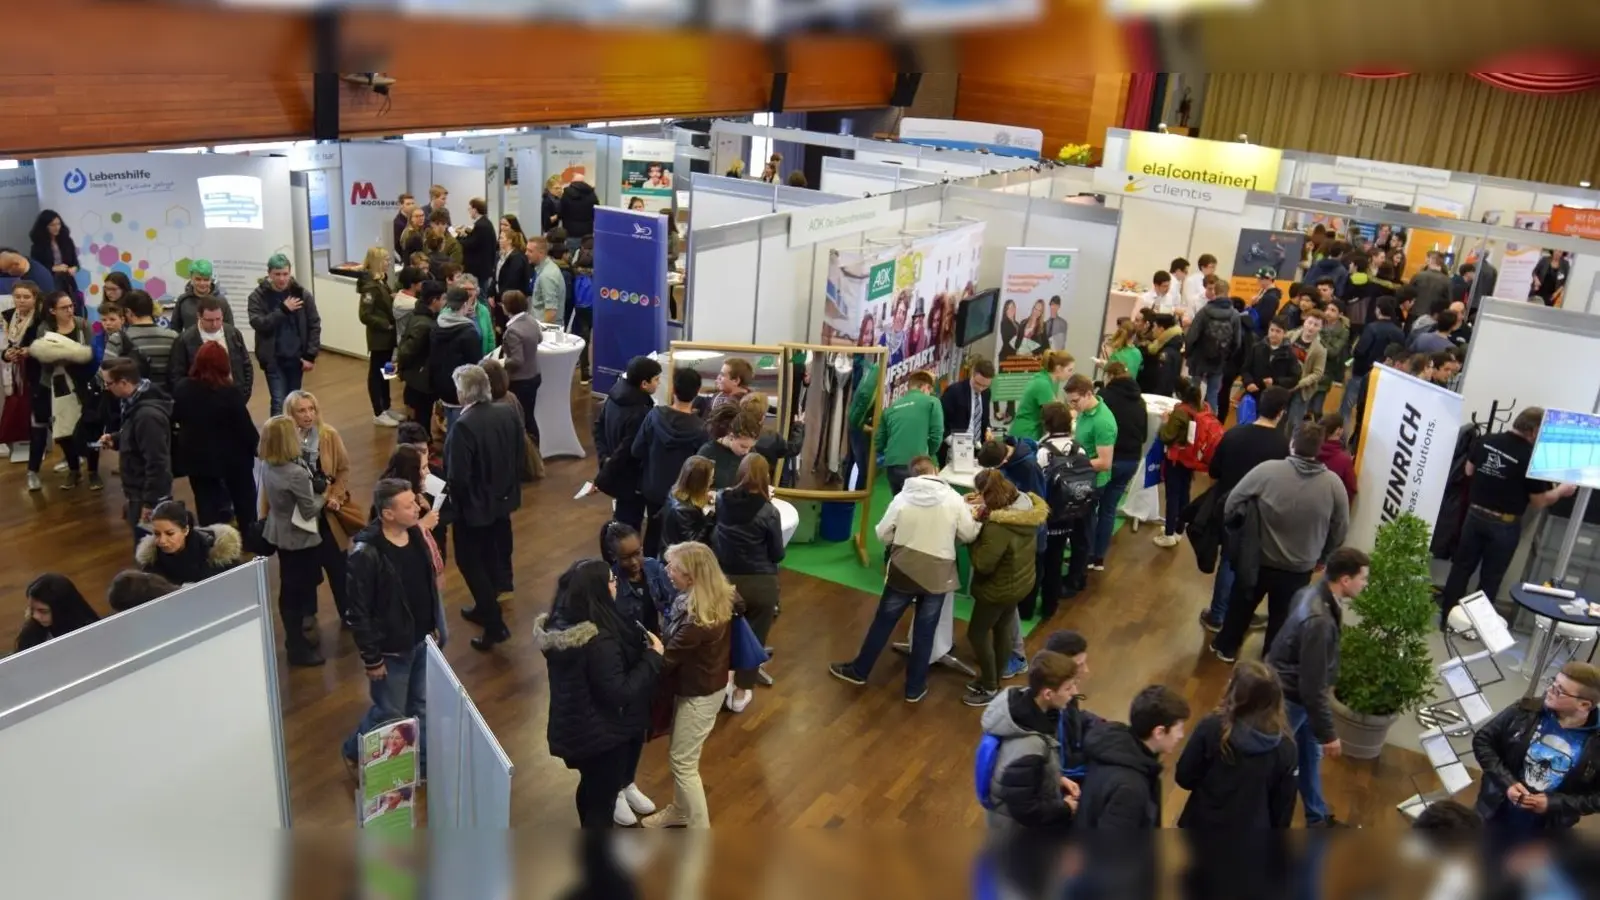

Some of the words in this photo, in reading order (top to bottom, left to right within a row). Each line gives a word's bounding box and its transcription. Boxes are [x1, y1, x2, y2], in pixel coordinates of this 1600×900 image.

[89, 169, 151, 182] Lebenshilfe
[1142, 163, 1258, 191] ela[container]
[1153, 183, 1212, 202] clientis
[872, 266, 892, 288] AOK
[1412, 418, 1437, 485] Solutions.
[1408, 488, 1420, 513] eas.
